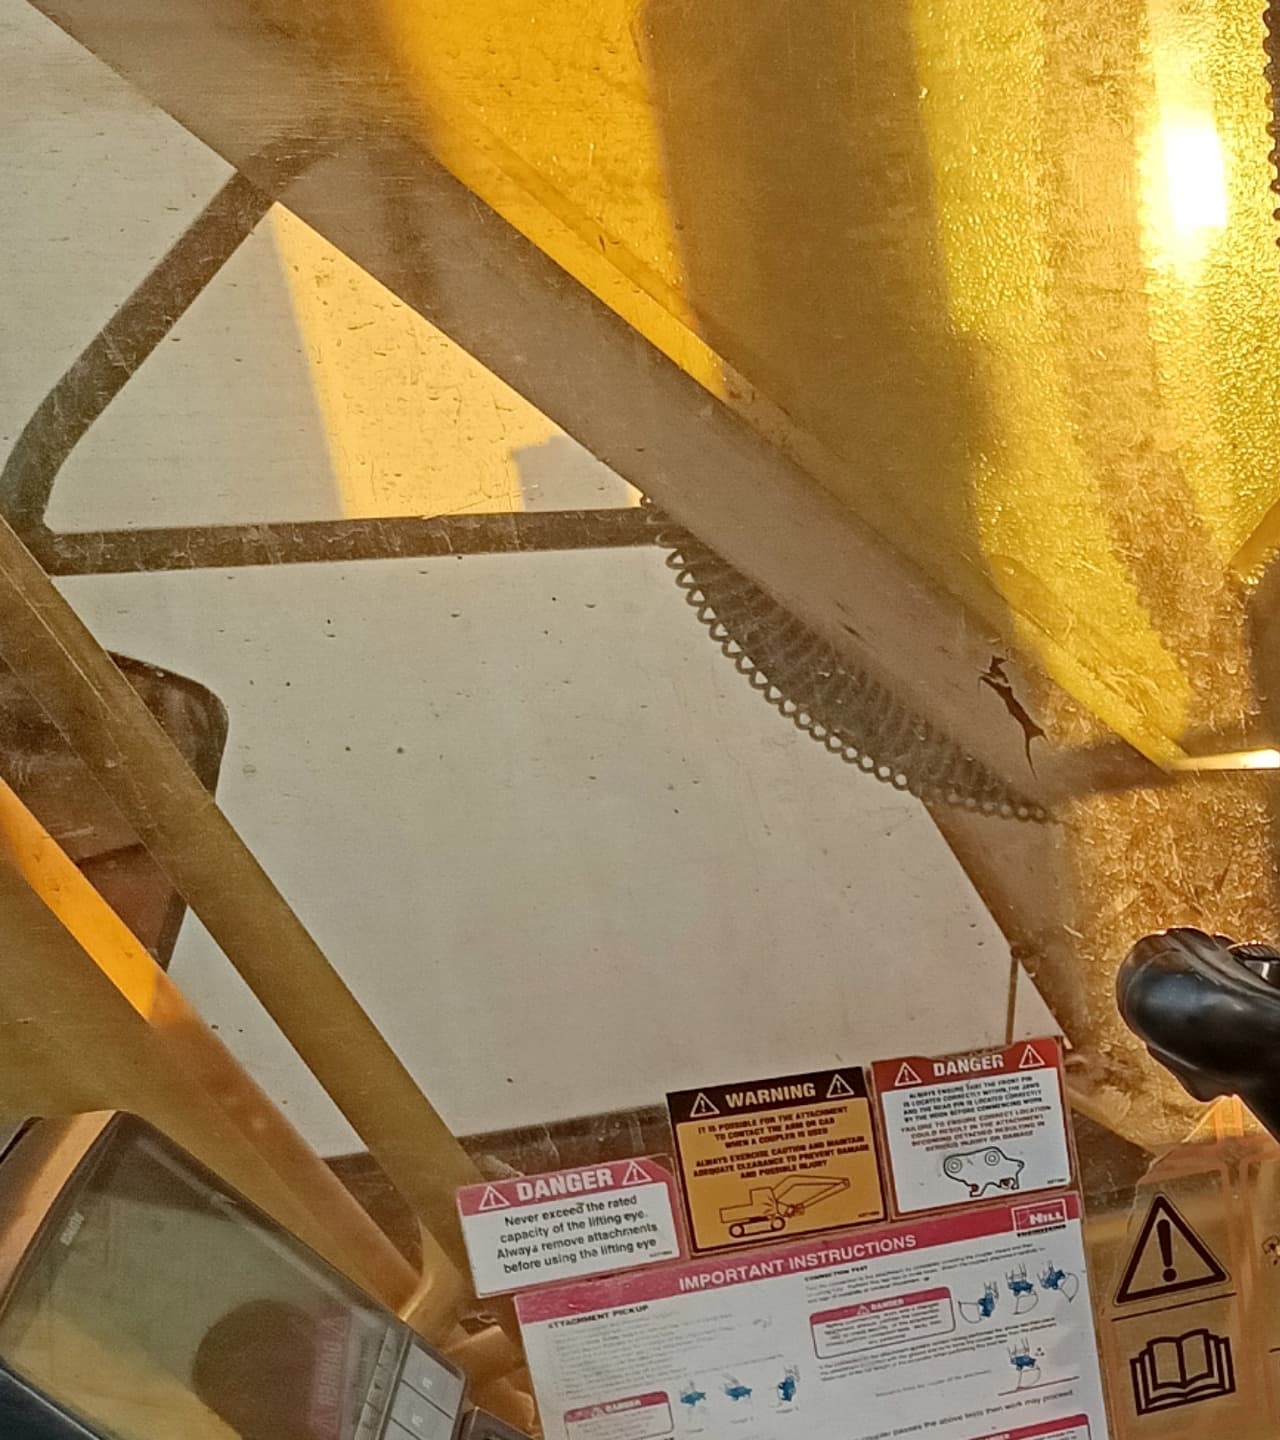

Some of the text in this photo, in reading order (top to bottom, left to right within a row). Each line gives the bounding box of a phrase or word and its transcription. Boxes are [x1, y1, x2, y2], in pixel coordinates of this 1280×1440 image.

[933, 1054, 1004, 1077] DANGER
[725, 1083, 816, 1108] WARNING
[516, 1168, 614, 1201] DANGER
[504, 1194, 637, 1226] Never exceed the rated
[499, 1225, 550, 1245] capacity
[551, 1223, 564, 1234] of
[566, 1219, 585, 1231] the
[588, 1212, 622, 1228] lifting
[541, 1235, 584, 1251] remove
[586, 1221, 657, 1243] attachments
[503, 1257, 541, 1273] before
[544, 1251, 577, 1267] using
[579, 1247, 597, 1259] the
[600, 1240, 634, 1257] lifting
[636, 1238, 656, 1250] eye
[679, 1259, 784, 1292] IMPORTANT
[788, 1235, 917, 1270] INSTRUCTIONS
[548, 1312, 609, 1329] ATTACHMENT
